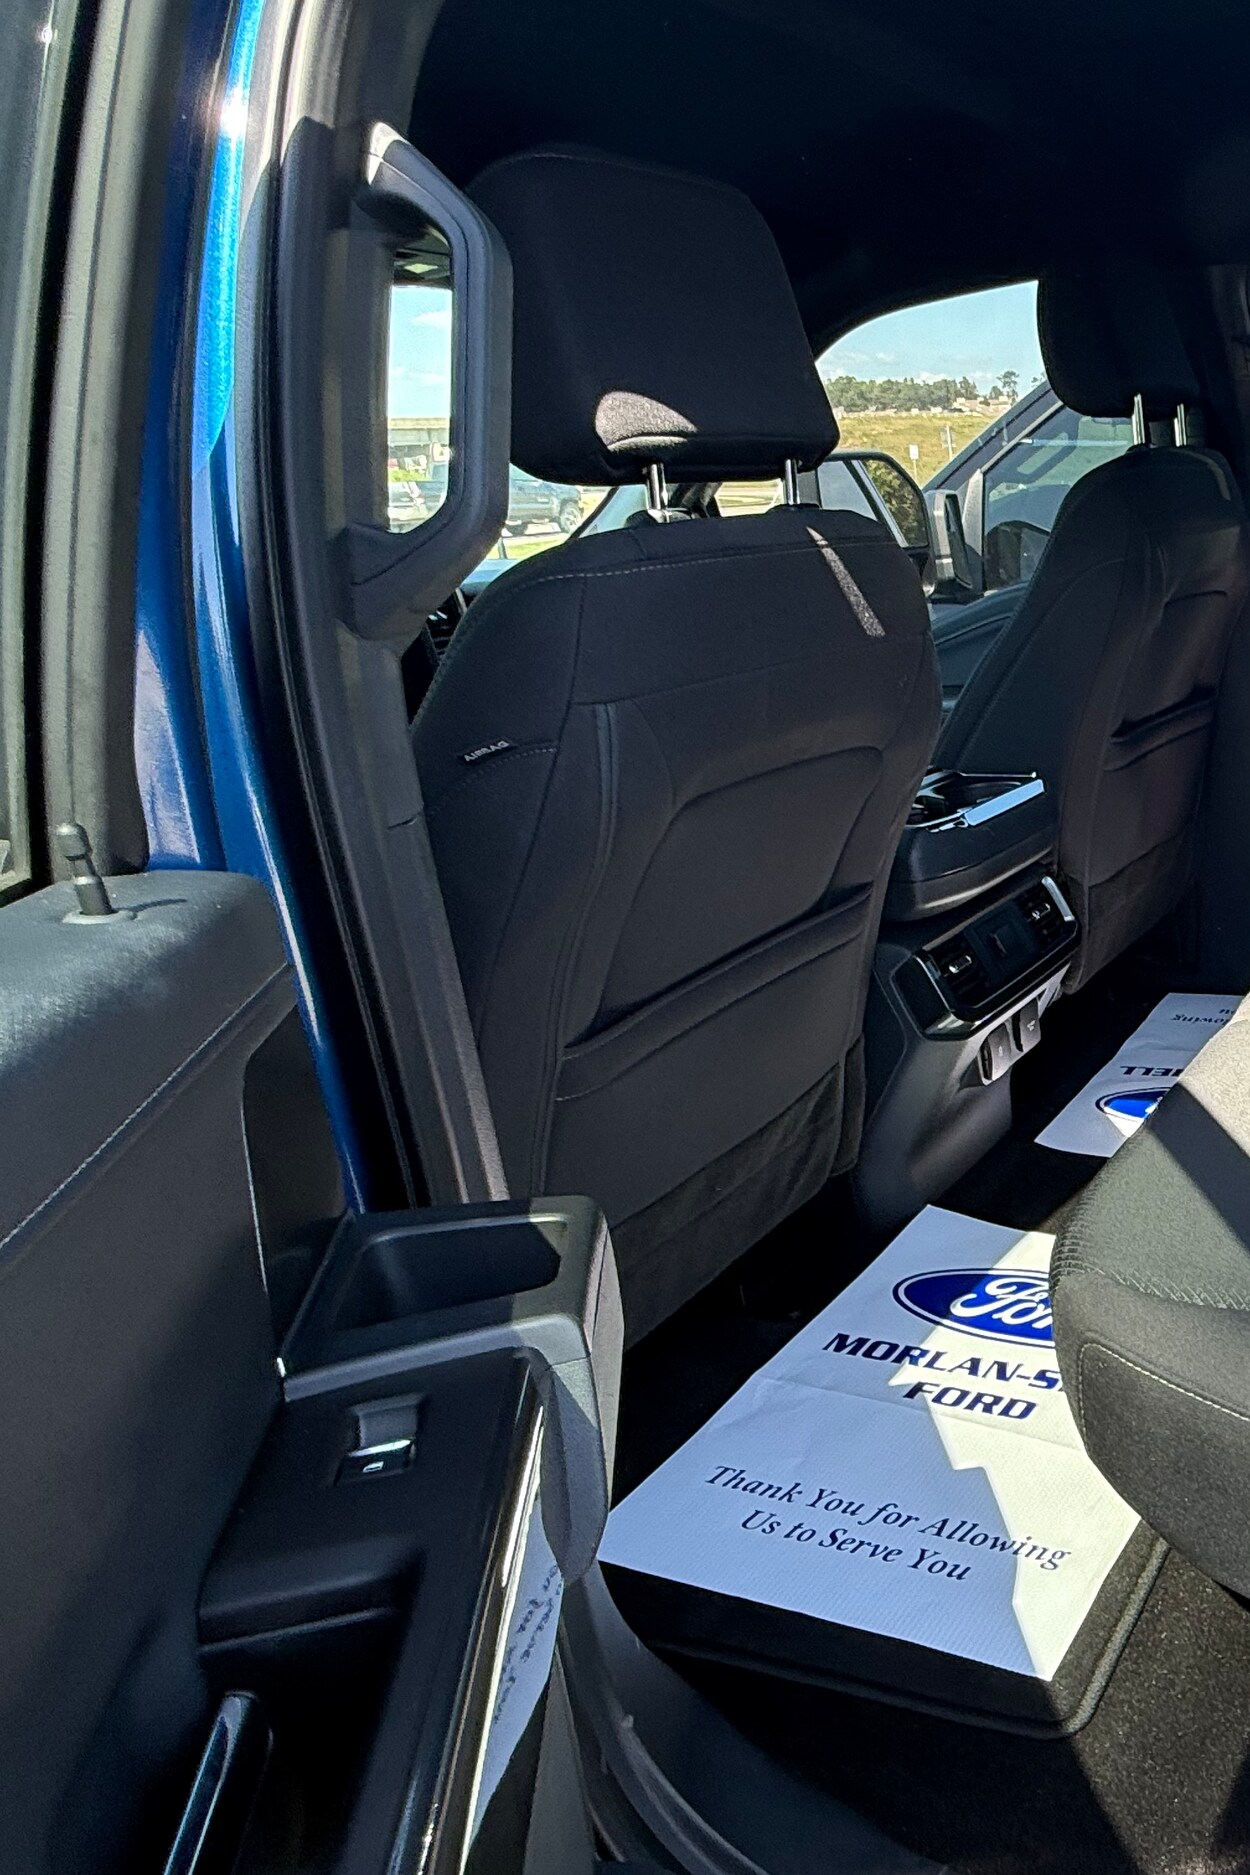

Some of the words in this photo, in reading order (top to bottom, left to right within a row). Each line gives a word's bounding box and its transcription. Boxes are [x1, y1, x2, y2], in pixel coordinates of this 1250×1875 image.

[1171, 1014, 1231, 1026] lowing
[1120, 1066, 1184, 1078] ELL
[822, 1333, 1064, 1393] MORLAN-S
[903, 1382, 1038, 1420] FORD
[705, 1465, 803, 1503] Thank
[805, 1488, 866, 1517] You
[857, 1502, 920, 1528] for
[918, 1517, 1072, 1571] Allowing
[741, 1509, 781, 1535] Us
[783, 1522, 817, 1543] to
[818, 1528, 904, 1563] Serve
[907, 1547, 972, 1581] You
